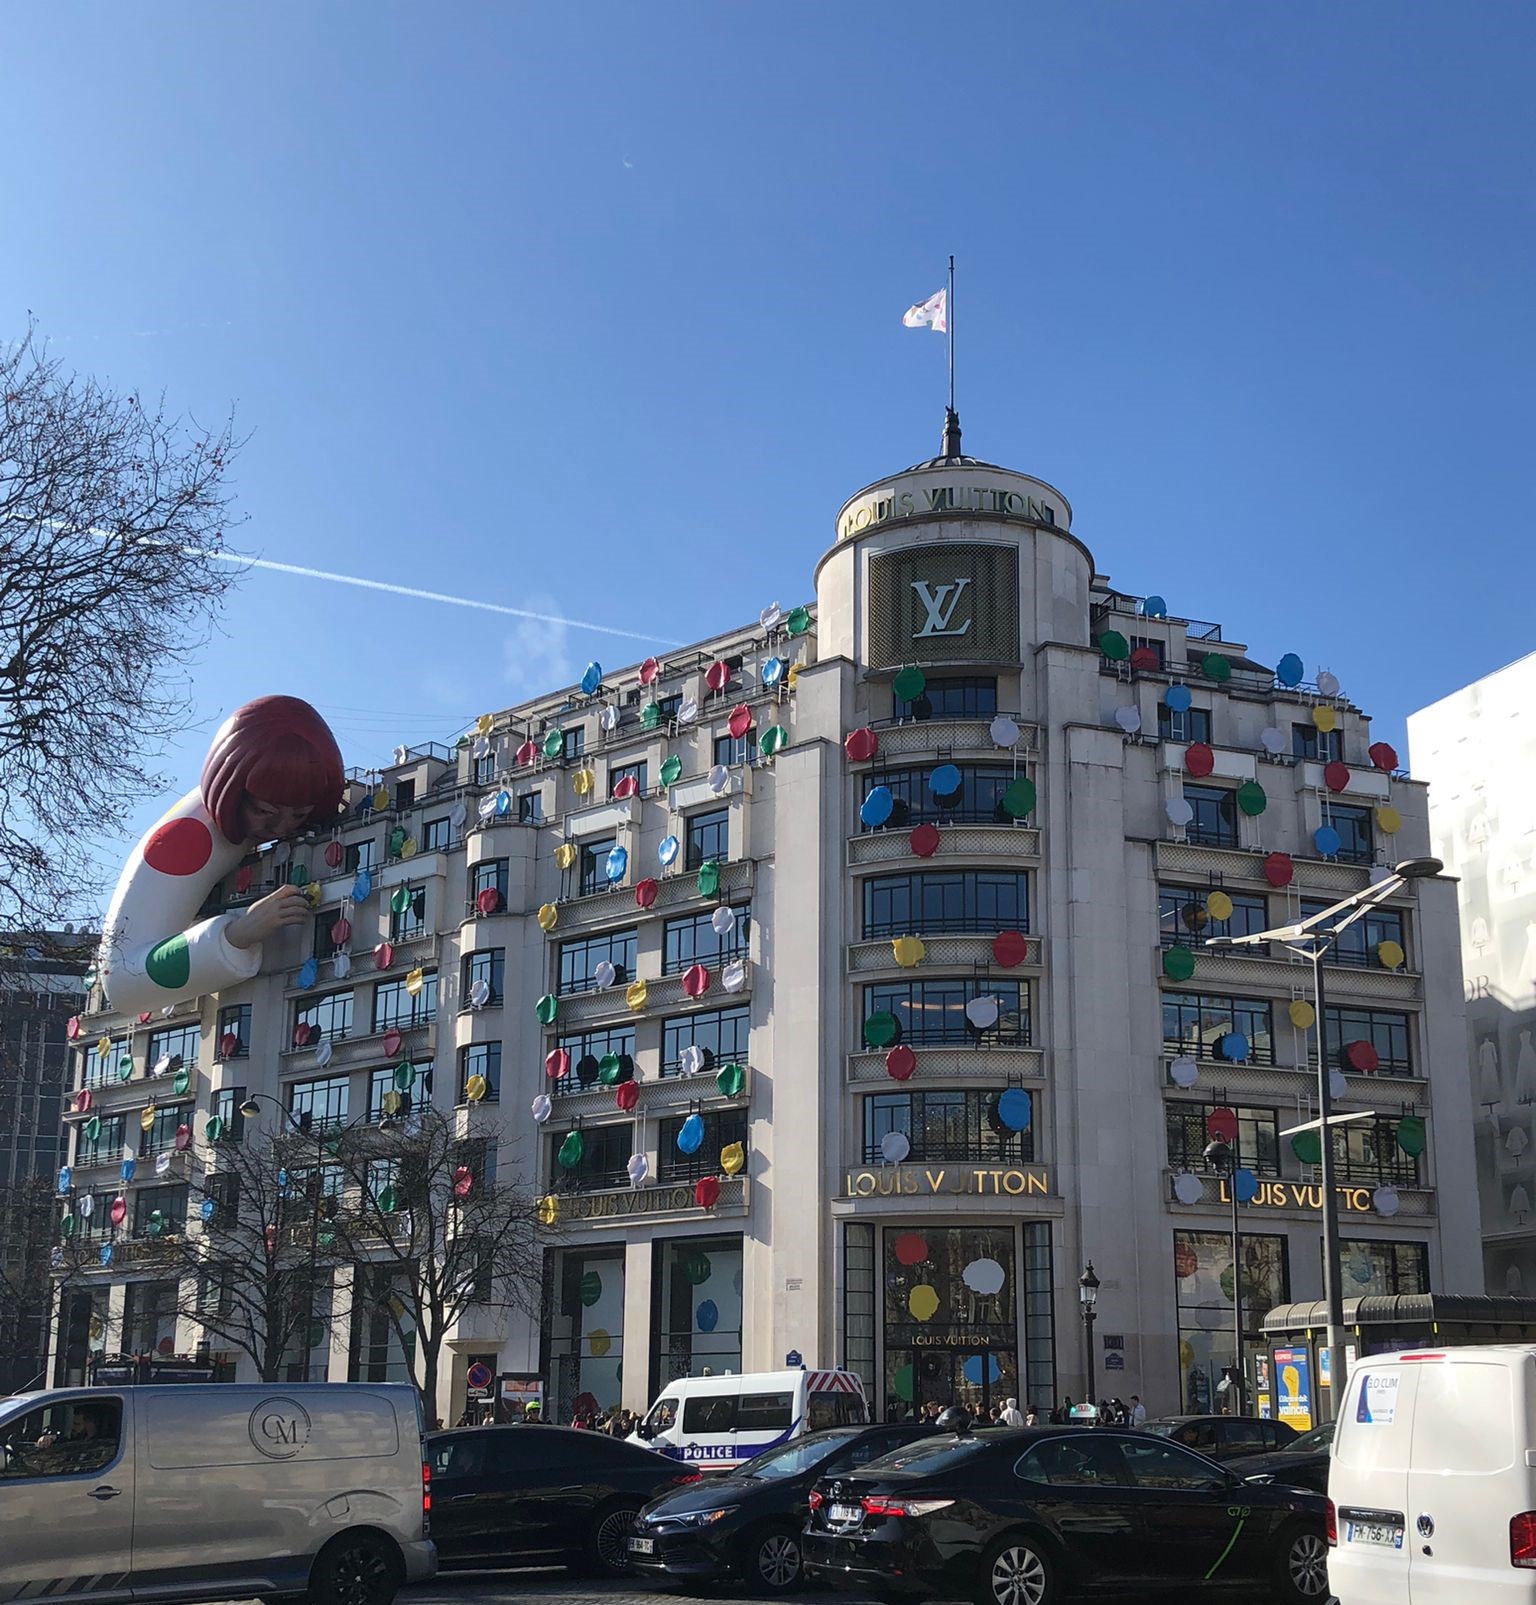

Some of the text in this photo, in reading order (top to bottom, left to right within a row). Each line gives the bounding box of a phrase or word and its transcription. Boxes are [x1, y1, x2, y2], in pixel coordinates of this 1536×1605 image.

[922, 487, 1048, 523] VUITTON
[846, 1170, 1049, 1197] LOUIS VUITTON
[1219, 1180, 1287, 1206] LUIS
[911, 1335, 990, 1346] LOUIS VUITTON
[683, 1446, 733, 1459] POLICE
